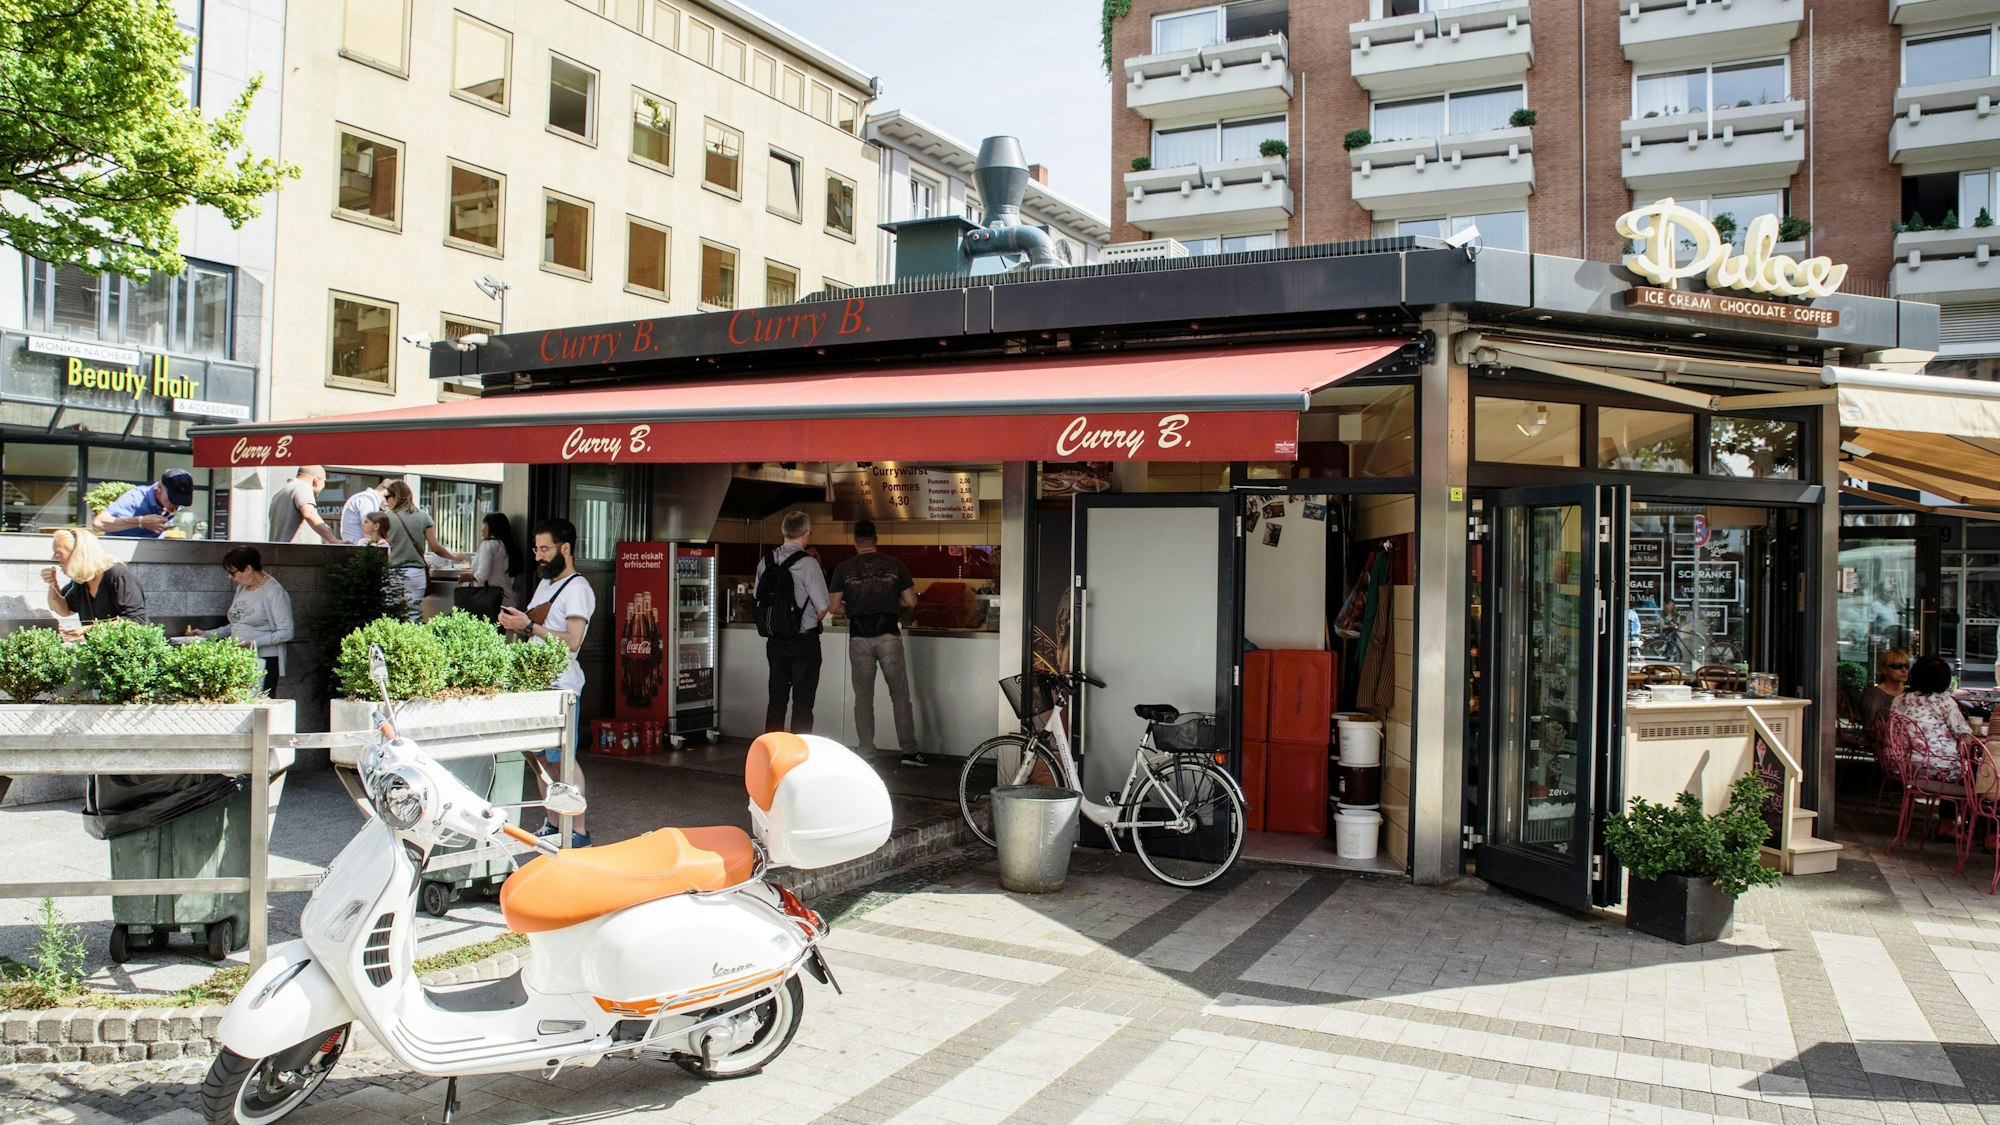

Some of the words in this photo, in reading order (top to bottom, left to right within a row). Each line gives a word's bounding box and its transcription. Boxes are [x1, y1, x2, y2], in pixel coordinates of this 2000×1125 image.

[1615, 197, 1848, 297] Dulce
[1645, 290, 1664, 304] ICE
[1668, 293, 1711, 310] CREAM
[1719, 301, 1787, 318] CHOCOLATE
[1793, 308, 1833, 324] COFFEE
[728, 310, 827, 347] Curry
[839, 297, 873, 335] B.
[540, 325, 622, 363] Curry
[632, 319, 660, 352] B.
[34, 340, 80, 355] MONIKA
[84, 347, 134, 362] NACHBAR
[68, 356, 147, 400] Beauty
[153, 354, 200, 400] Hair
[178, 402, 186, 411] &
[187, 403, 246, 418] ACCESSOIRES
[1056, 415, 1145, 458] Curry
[1157, 413, 1193, 449] B.
[561, 425, 621, 461] Curry
[629, 424, 652, 453] B.
[230, 437, 271, 464] Curry
[275, 434, 293, 458] B.
[872, 466, 928, 478] Currywurst
[882, 482, 920, 492] Pommes
[928, 478, 949, 486] Pommes
[959, 477, 971, 485] 2,00
[928, 487, 950, 495] Pommes
[960, 487, 972, 495] 2,50
[888, 496, 910, 508] 4,30
[961, 497, 973, 505] 0,40
[621, 552, 639, 561] Jetzt
[640, 552, 664, 560] eiskalt
[623, 560, 661, 569] erfrischen!
[1629, 580, 1654, 589] GALE
[1683, 585, 1704, 593] nah
[1548, 788, 1569, 797] zero
